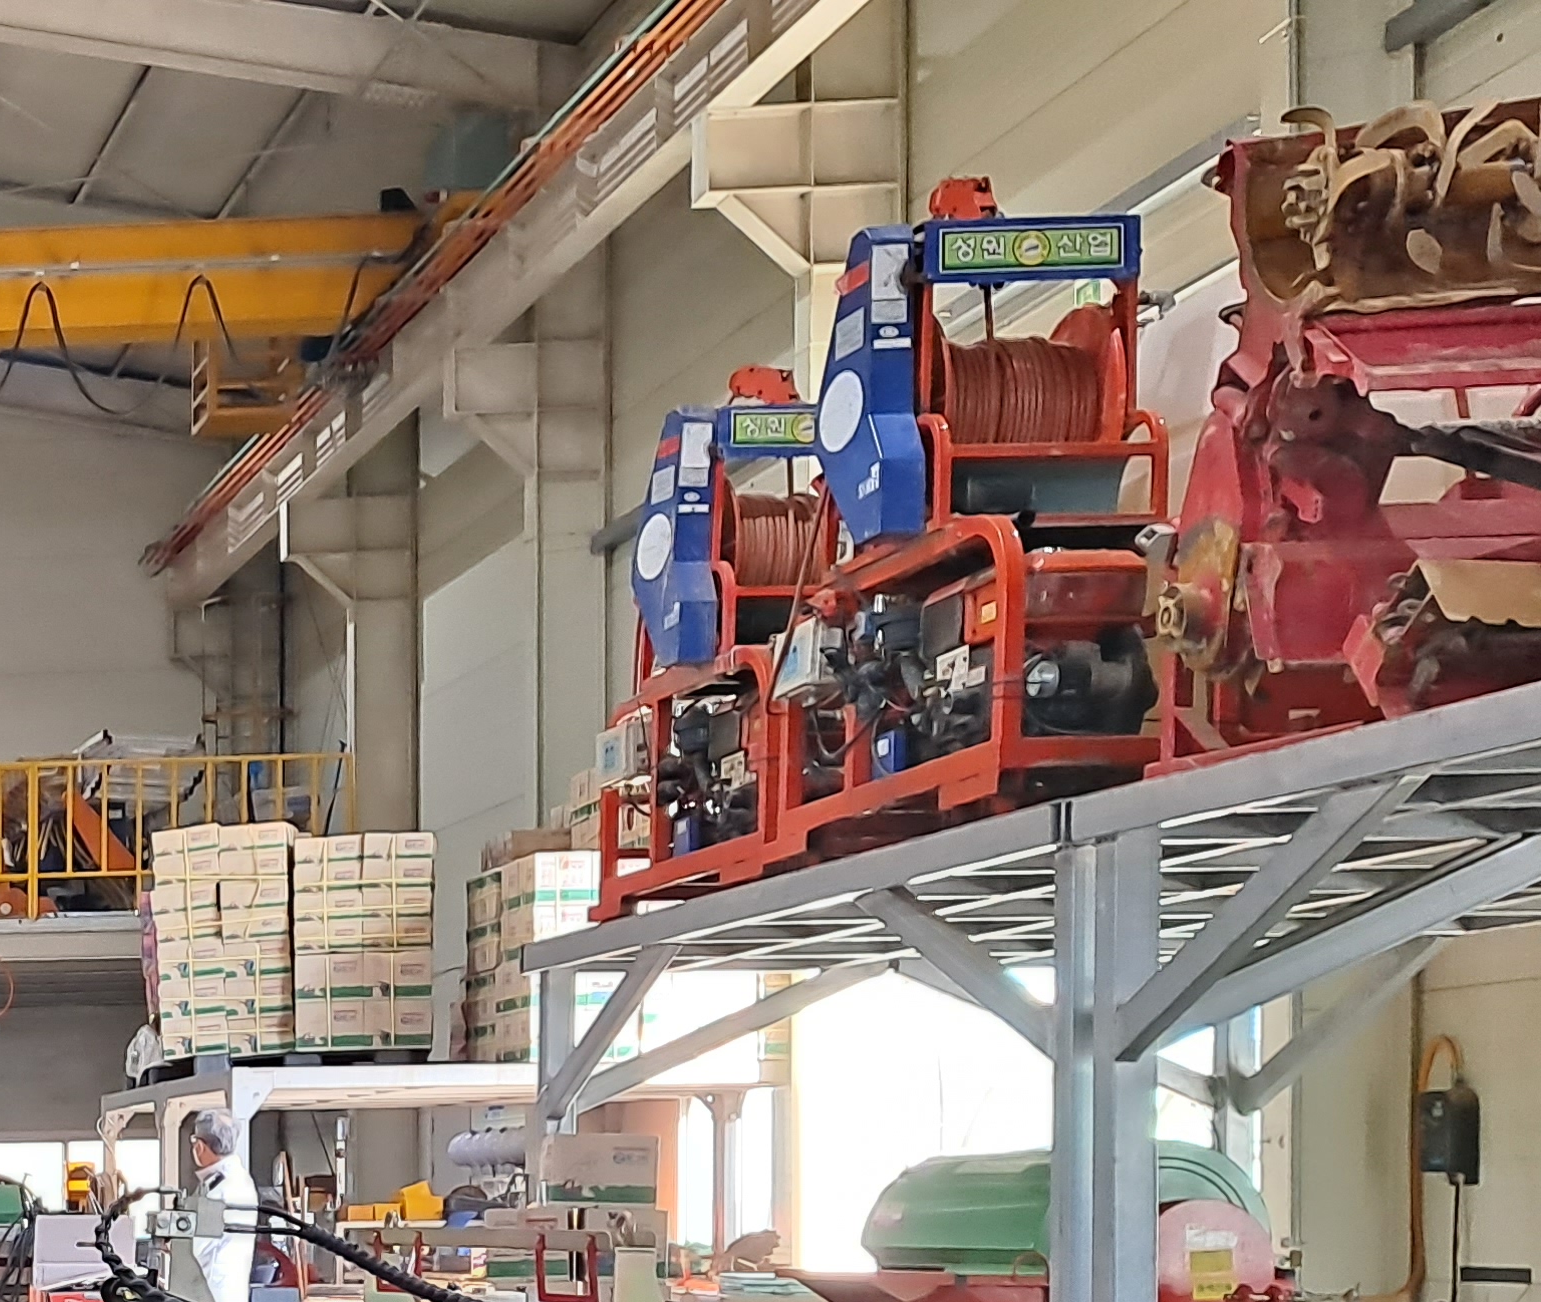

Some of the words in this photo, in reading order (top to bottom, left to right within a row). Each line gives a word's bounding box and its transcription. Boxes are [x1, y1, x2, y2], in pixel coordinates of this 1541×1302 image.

[951, 235, 1006, 262] 성원
[1057, 232, 1112, 257] 산업
[742, 417, 785, 437] 성원
